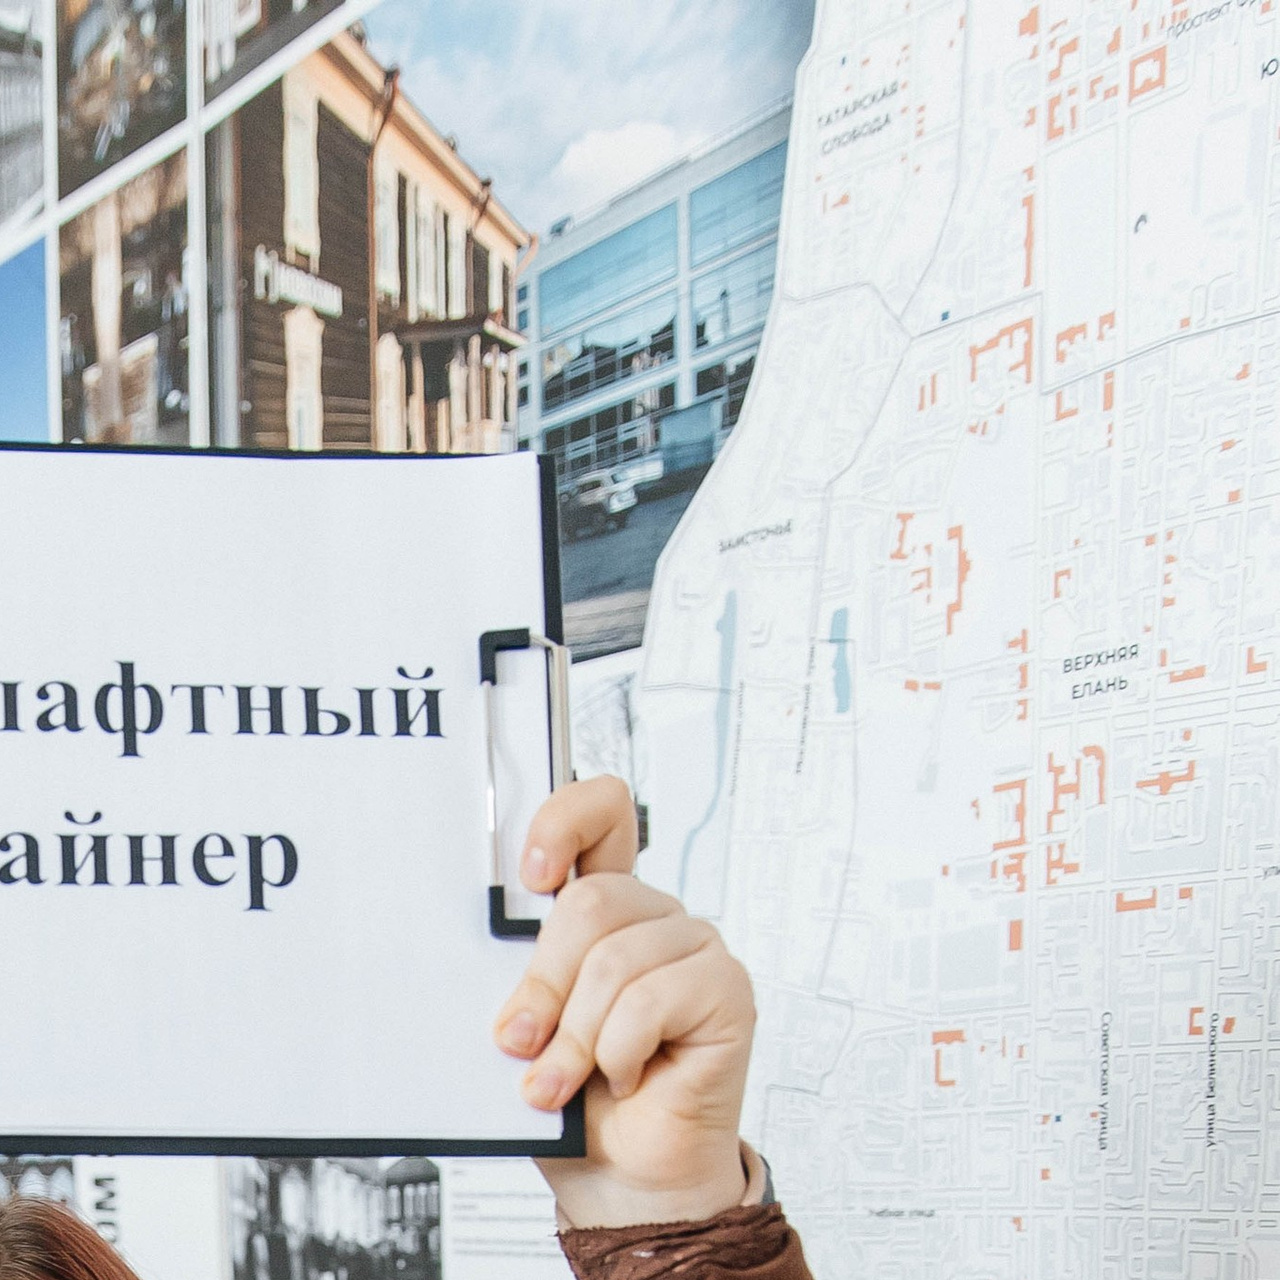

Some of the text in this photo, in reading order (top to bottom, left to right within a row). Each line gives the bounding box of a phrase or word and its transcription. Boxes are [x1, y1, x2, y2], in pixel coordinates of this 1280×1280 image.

[1063, 643, 1139, 673] ВЕРХНЯЯ
[1072, 676, 1128, 699] ЕЛАНЬ
[1098, 1011, 1113, 1151] Советская улица
[1205, 1012, 1220, 1148] улица Белинского
